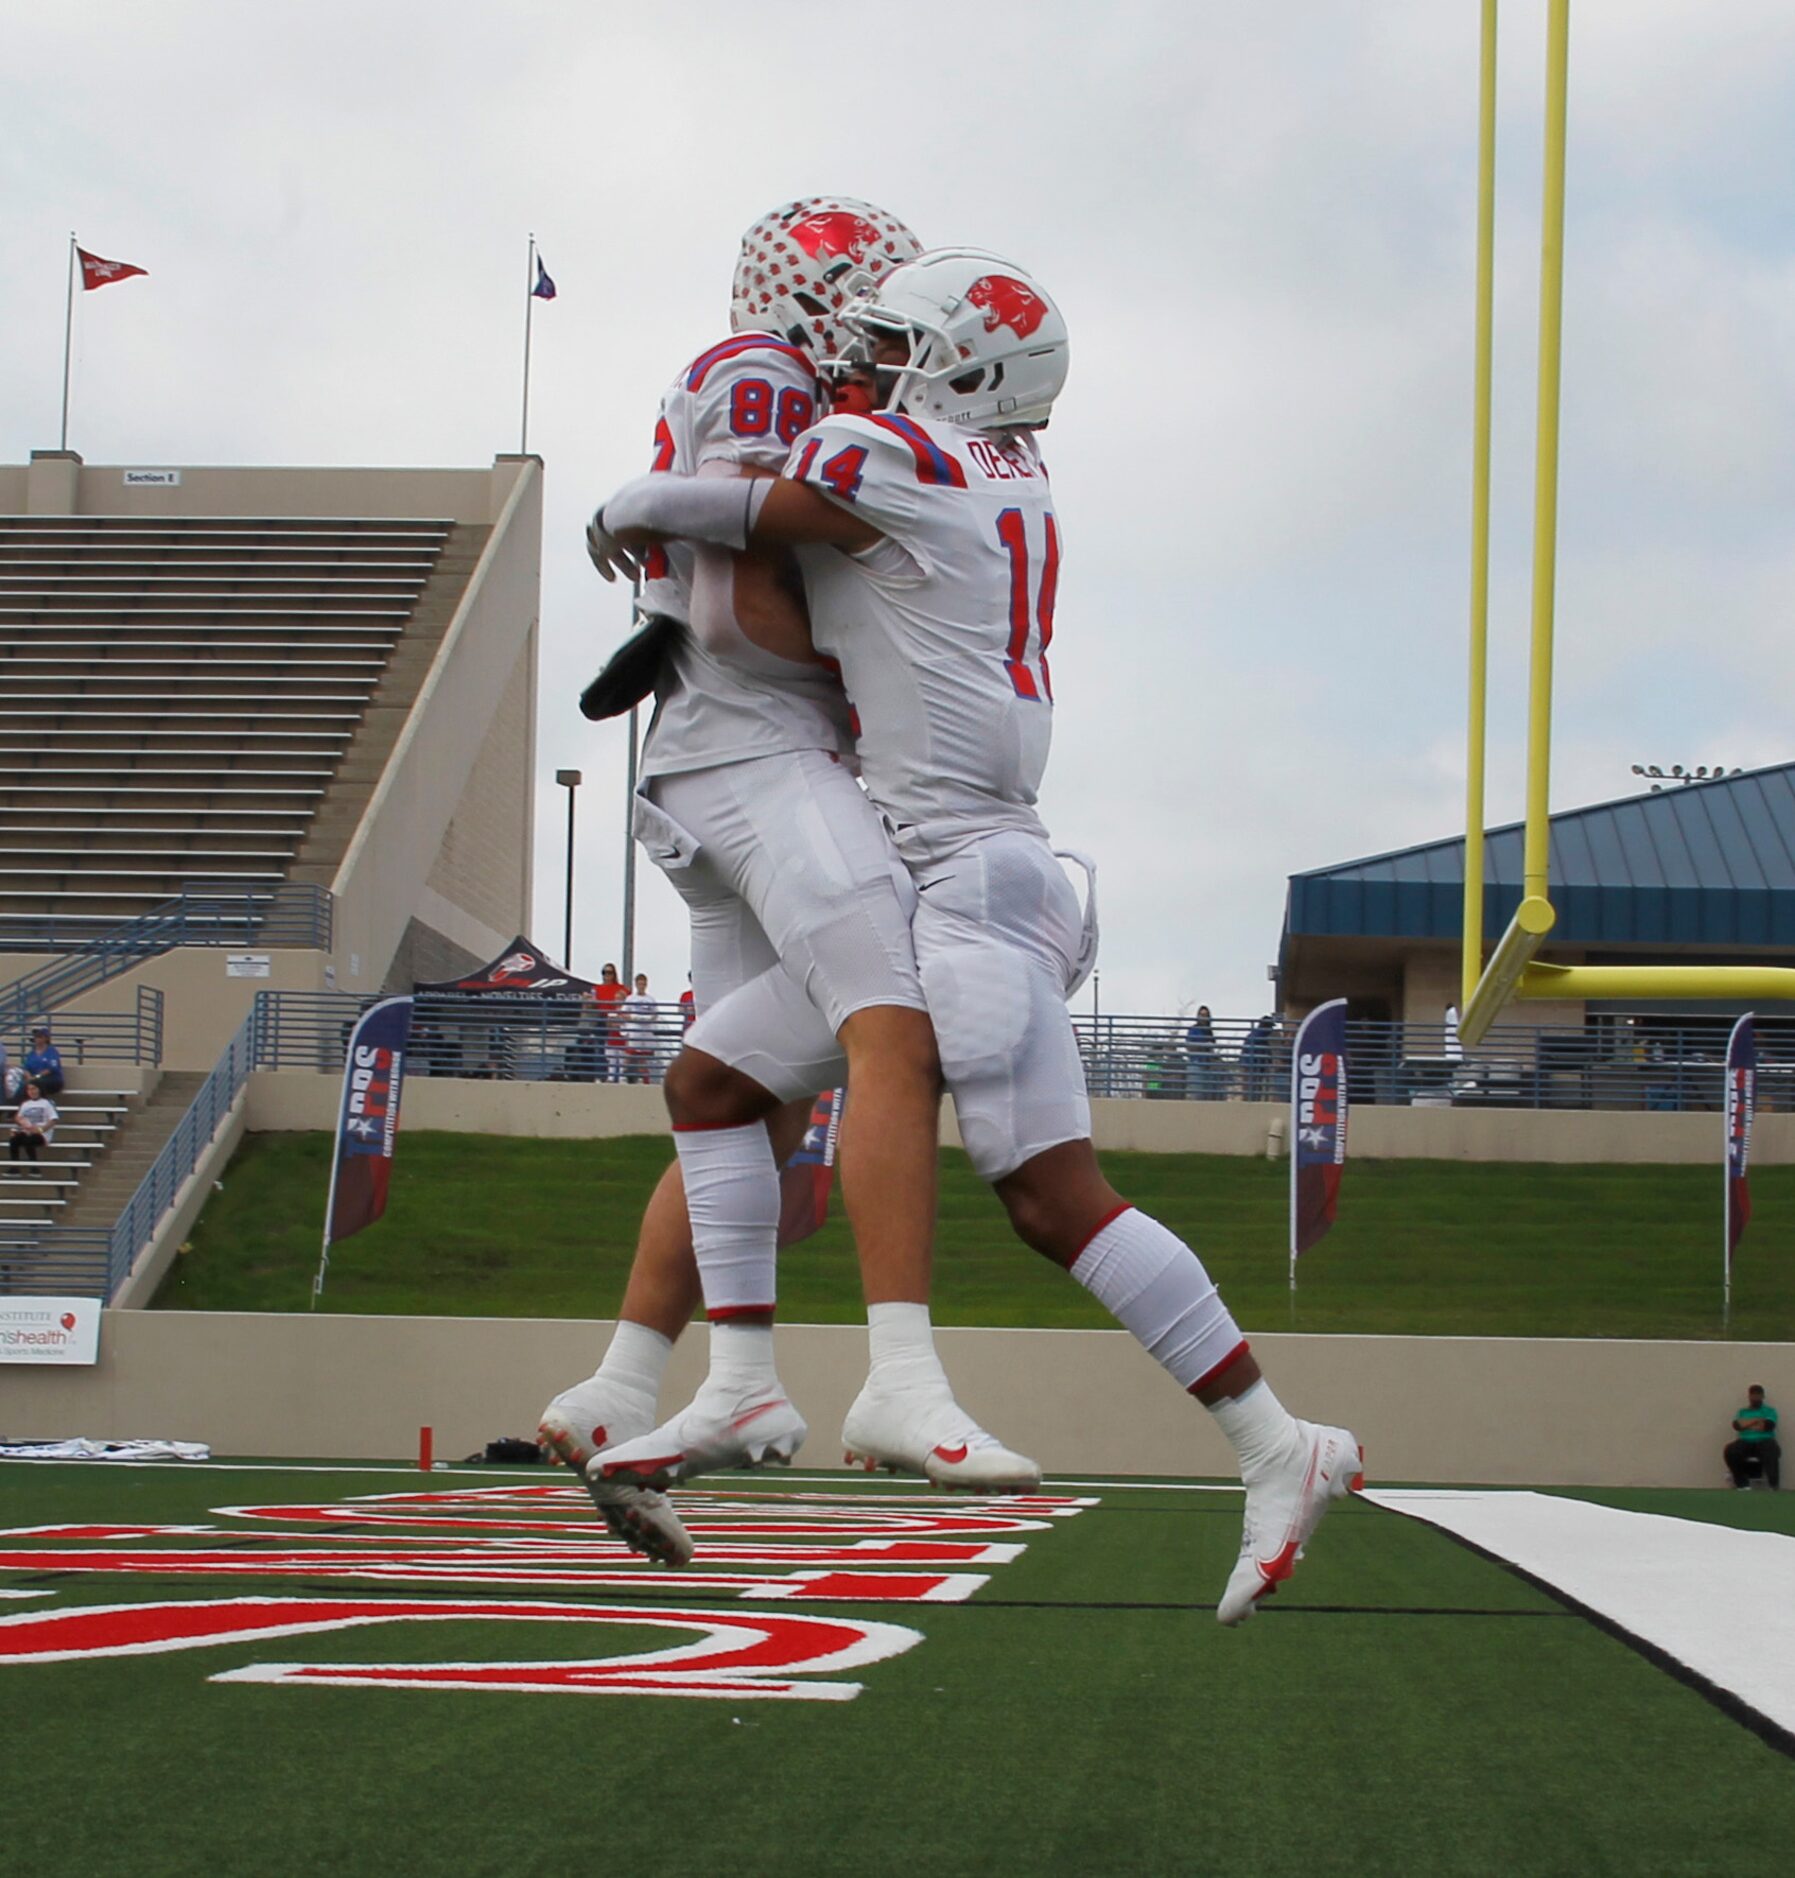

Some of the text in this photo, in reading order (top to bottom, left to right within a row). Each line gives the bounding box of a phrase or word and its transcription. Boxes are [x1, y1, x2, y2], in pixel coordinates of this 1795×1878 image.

[730, 378, 814, 447] 88
[127, 472, 165, 482] Section
[793, 437, 869, 503] 14
